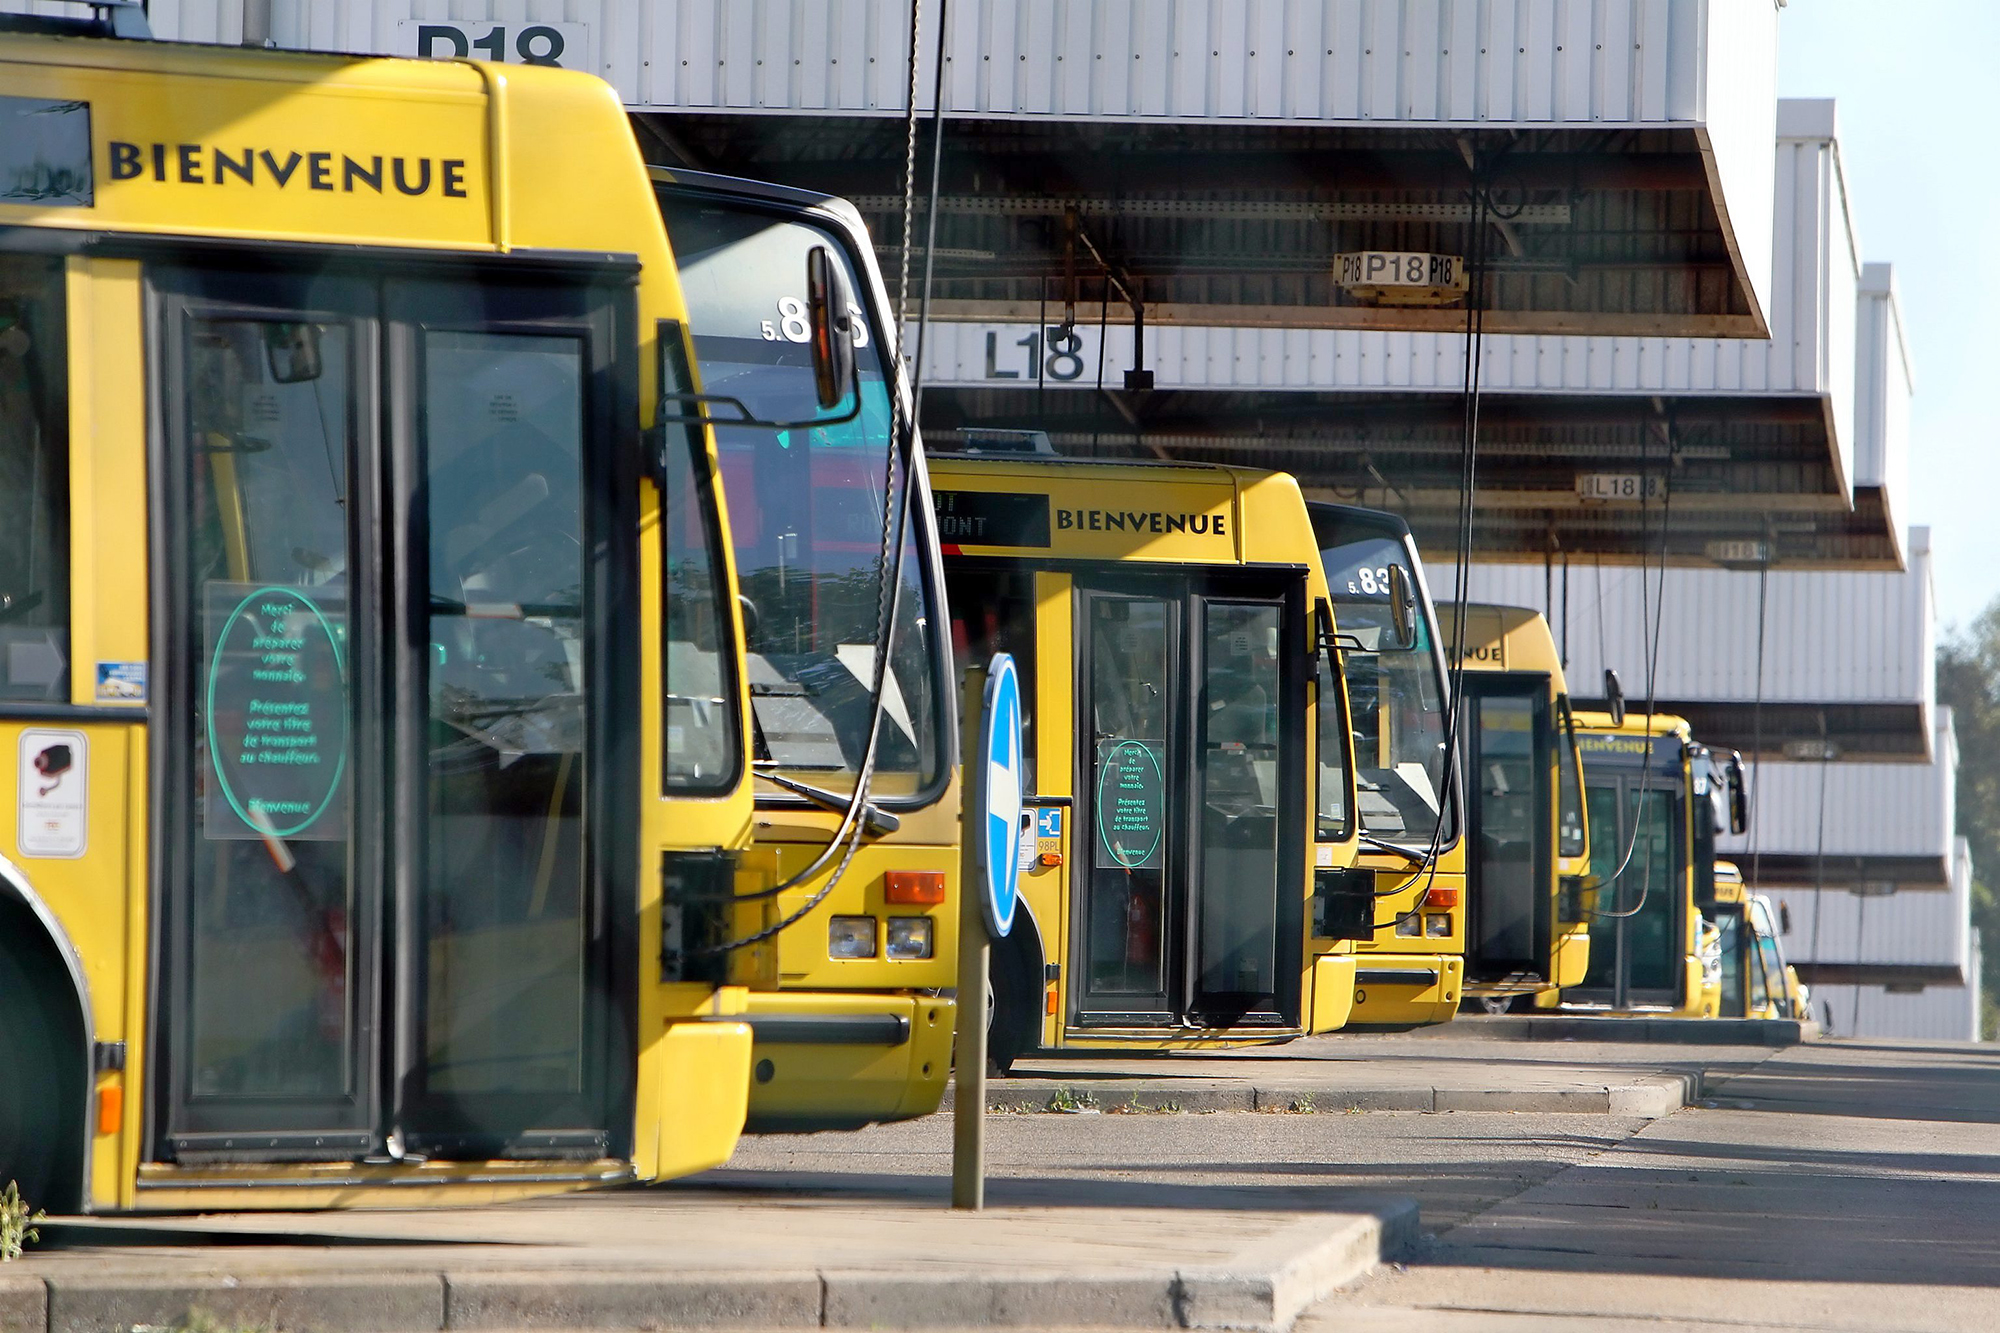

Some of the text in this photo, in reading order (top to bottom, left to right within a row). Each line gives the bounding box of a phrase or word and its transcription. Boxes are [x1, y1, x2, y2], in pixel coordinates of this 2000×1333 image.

[109, 141, 468, 198] BIENVENUE
[1342, 256, 1361, 282] P18
[1366, 254, 1424, 283] P18
[1429, 256, 1453, 285] P18
[986, 331, 1084, 380] L18
[1596, 477, 1634, 496] L18
[1057, 509, 1226, 536] BIENVENUE
